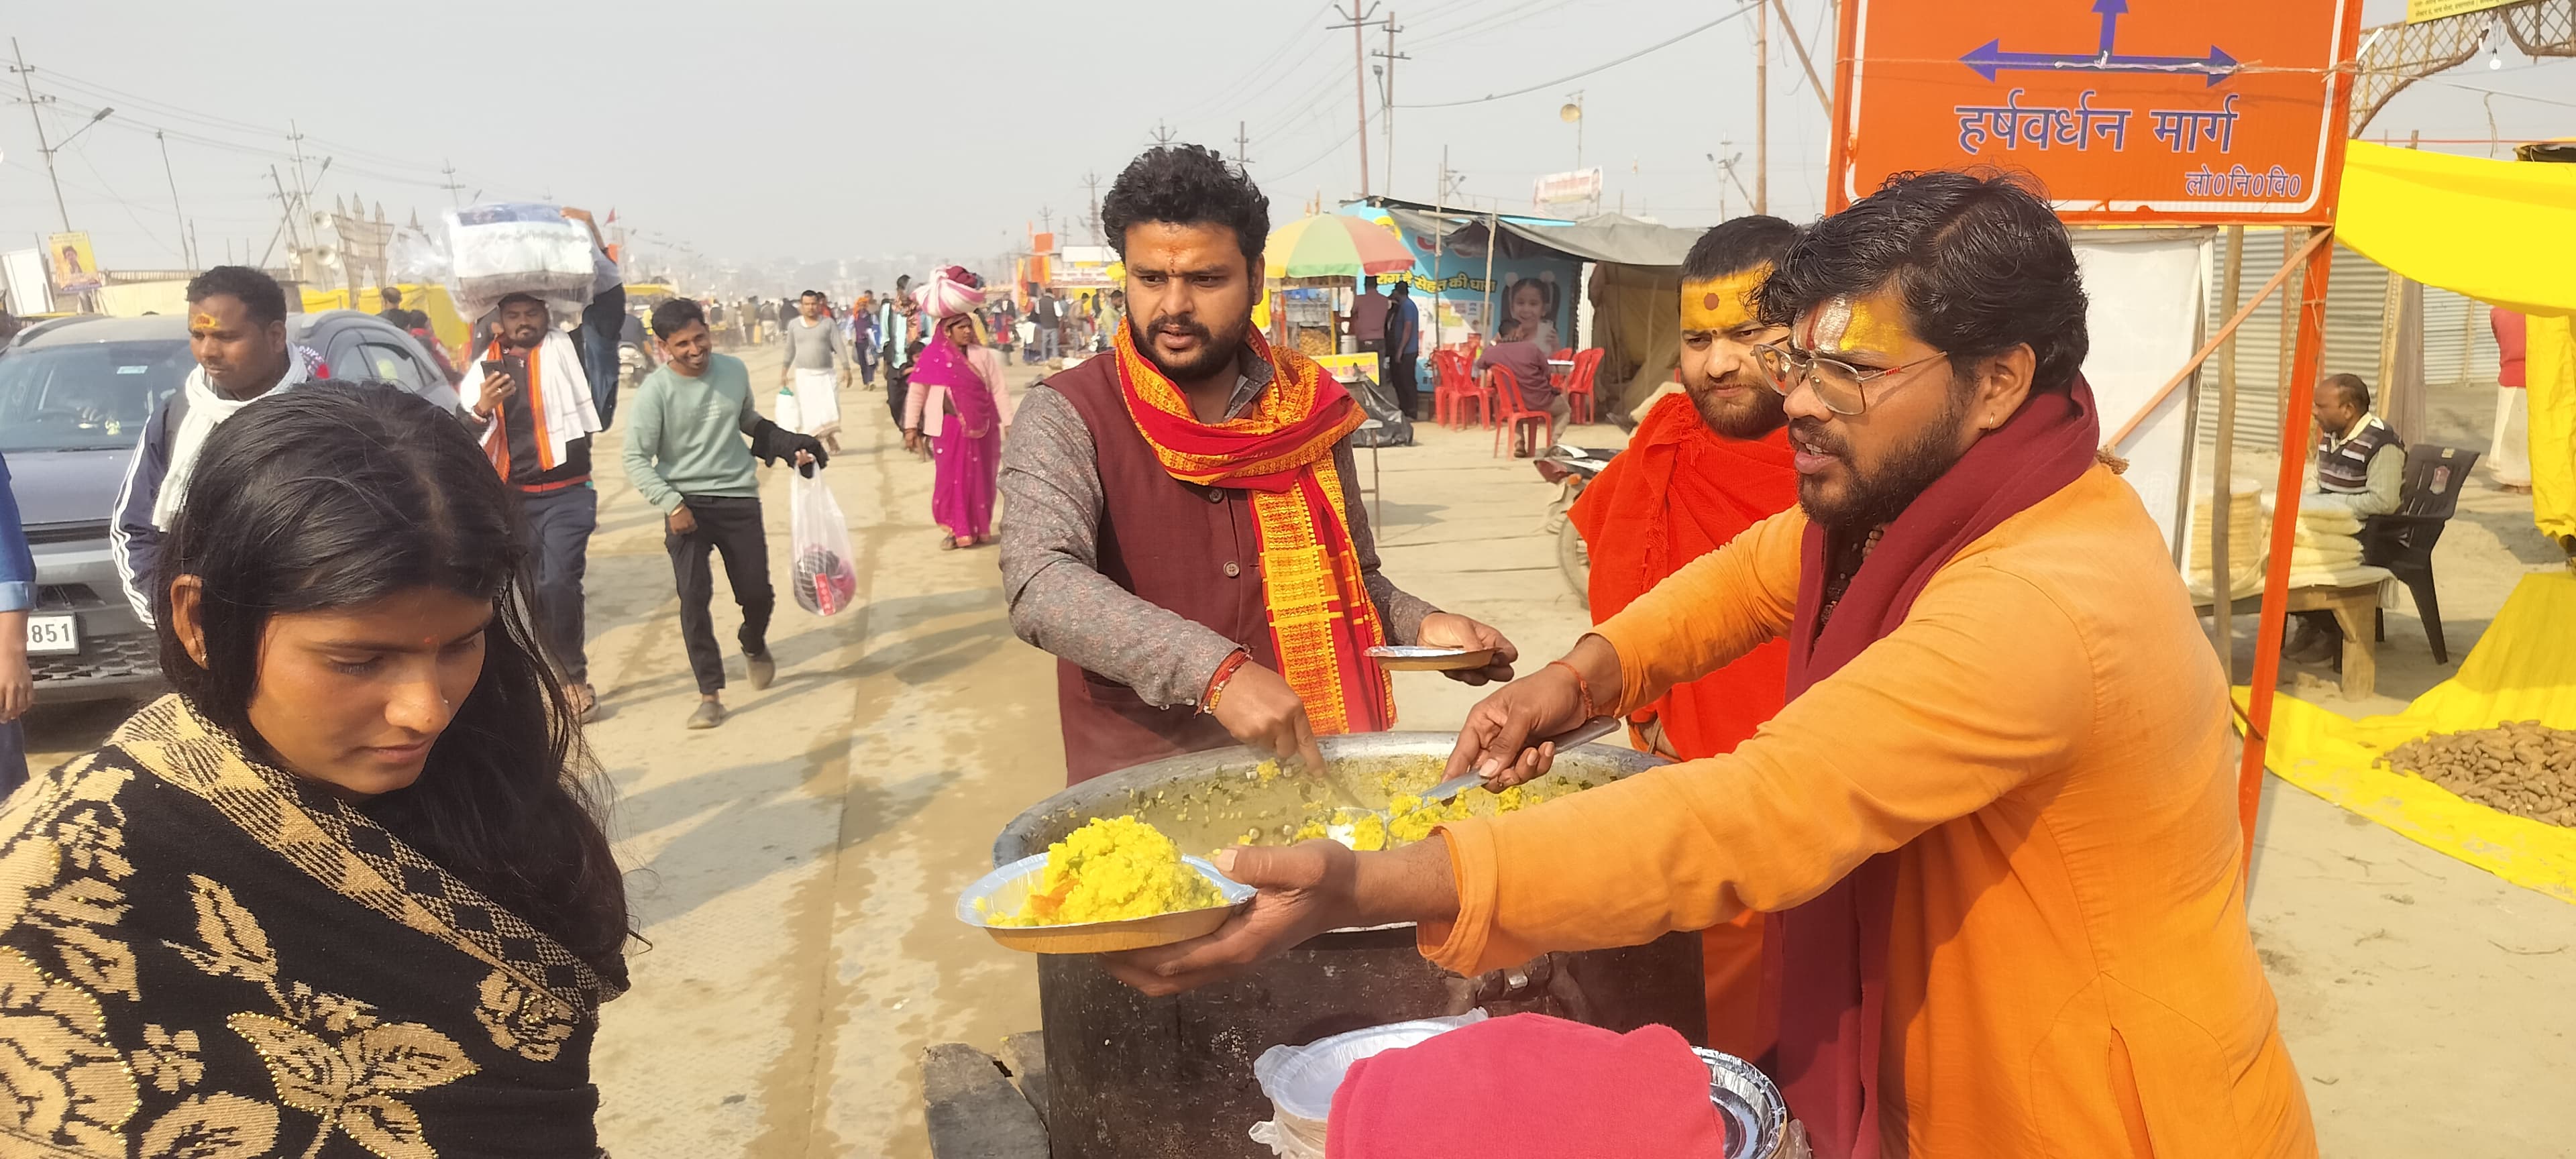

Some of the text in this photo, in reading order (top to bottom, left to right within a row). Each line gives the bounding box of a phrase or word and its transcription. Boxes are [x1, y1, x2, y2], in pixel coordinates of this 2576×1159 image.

[1955, 89, 2239, 154] हर्षवर्धन मार्ग
[1448, 272, 1468, 290] की
[1470, 278, 1497, 292] धाा
[28, 622, 70, 643] 851
